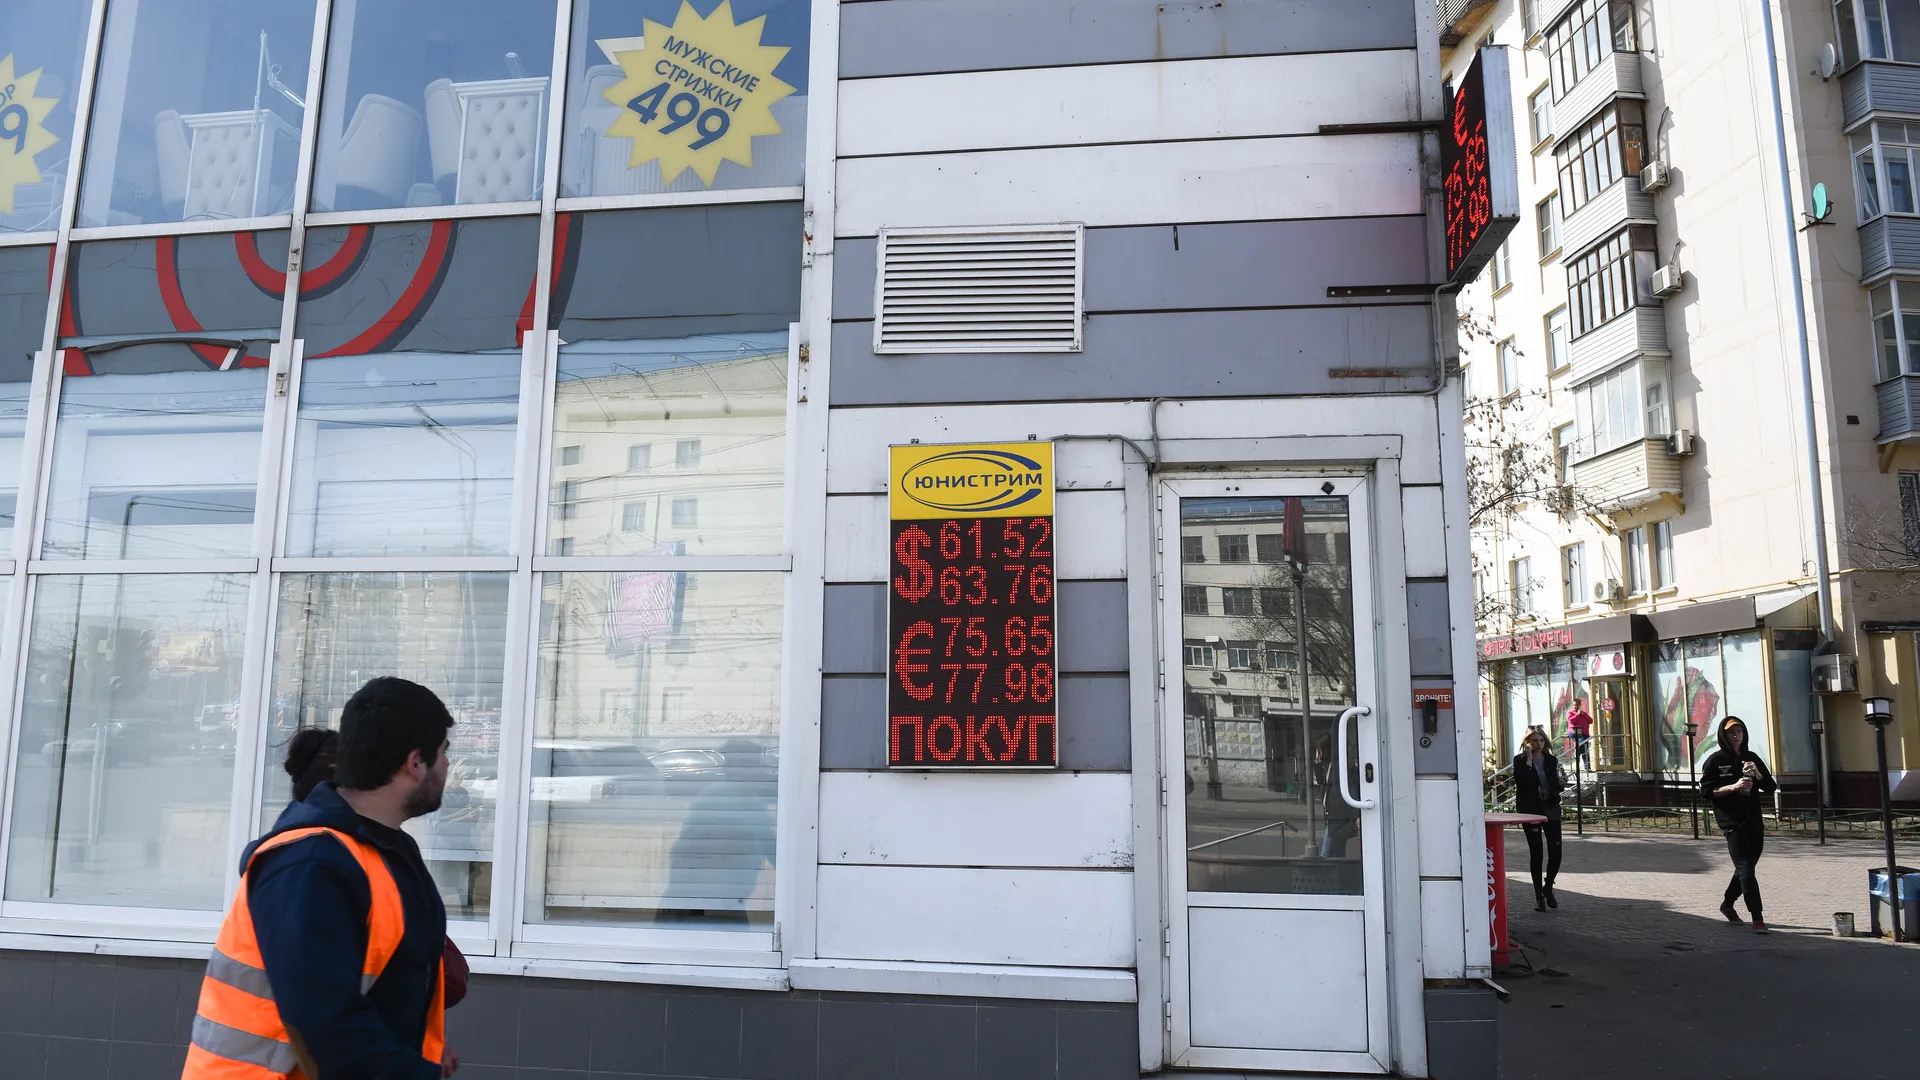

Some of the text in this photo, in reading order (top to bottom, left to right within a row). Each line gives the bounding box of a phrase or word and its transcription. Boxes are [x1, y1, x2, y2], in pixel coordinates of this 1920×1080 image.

[655, 59, 743, 112] СТРИЖКИ
[662, 35, 761, 93] МУЖСКИЕ
[626, 81, 731, 151] 499
[1445, 120, 1486, 222] 75.65
[1447, 175, 1490, 270] 77.98
[915, 473, 1042, 489] ЮНИСТРИМ
[895, 524, 933, 603] $
[940, 518, 1051, 559] 61.52
[940, 564, 1052, 605] 63.76
[895, 620, 934, 701] €
[940, 615, 1052, 657] 75.65
[940, 663, 1053, 703] 77.98
[891, 715, 1056, 761] ПОКУП
